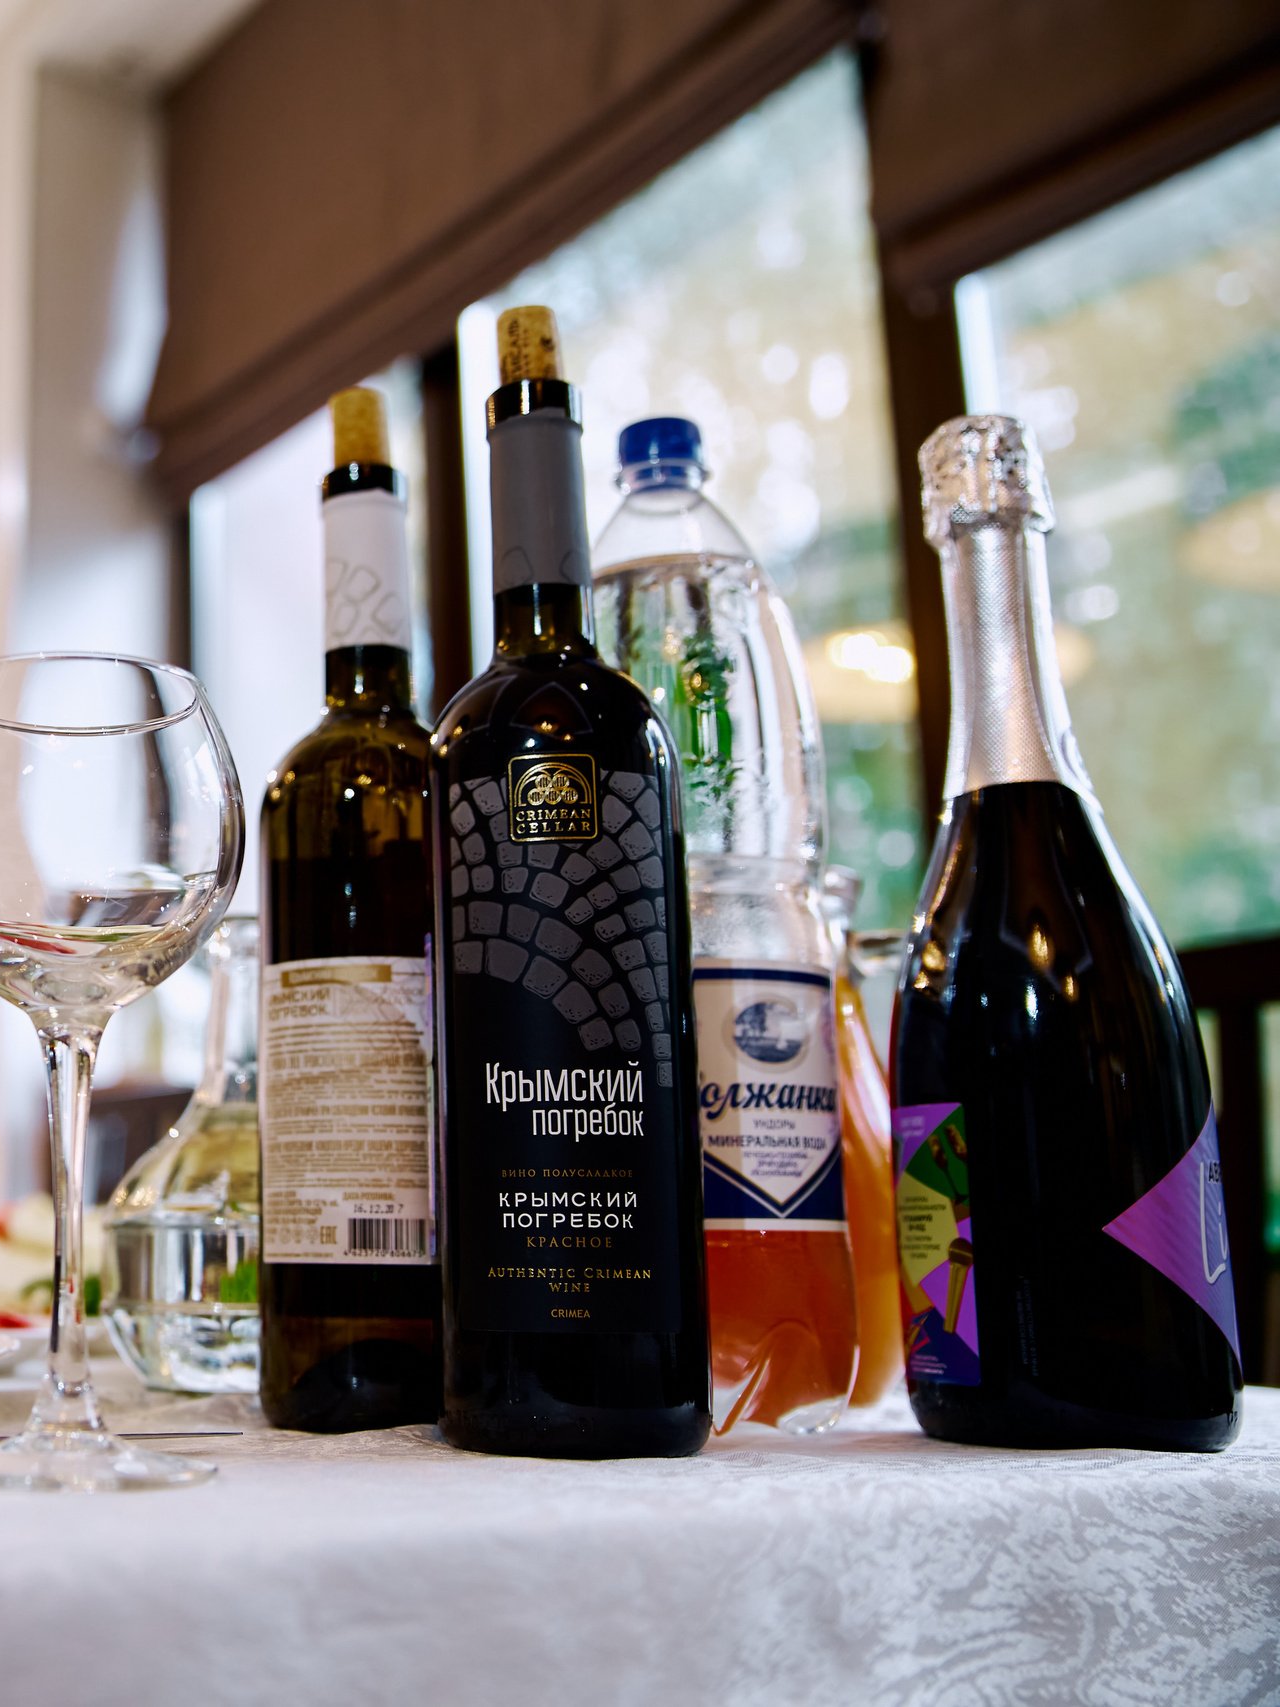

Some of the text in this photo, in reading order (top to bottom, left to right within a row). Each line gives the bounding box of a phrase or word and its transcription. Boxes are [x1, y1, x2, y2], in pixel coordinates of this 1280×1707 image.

[516, 808, 591, 822] CRIMEAN
[516, 821, 591, 834] CELLAR
[485, 1060, 644, 1112] Крымский
[699, 1071, 837, 1120] олжанка
[532, 1102, 645, 1143] погребок
[707, 1135, 801, 1148] МИНЕРАЛЬНАЯ
[501, 1168, 634, 1179] ВИНО ПОЛУСЛАДКОЕ
[499, 1191, 638, 1208] КРЫМСКИЙ
[503, 1212, 634, 1229] ПОГРЕБОК
[526, 1236, 613, 1248] КРАСНОЕ
[488, 1266, 652, 1280] AUTHENTIC CRIMEAN
[548, 1282, 591, 1293] WINE
[550, 1308, 591, 1319] CRIMEA
